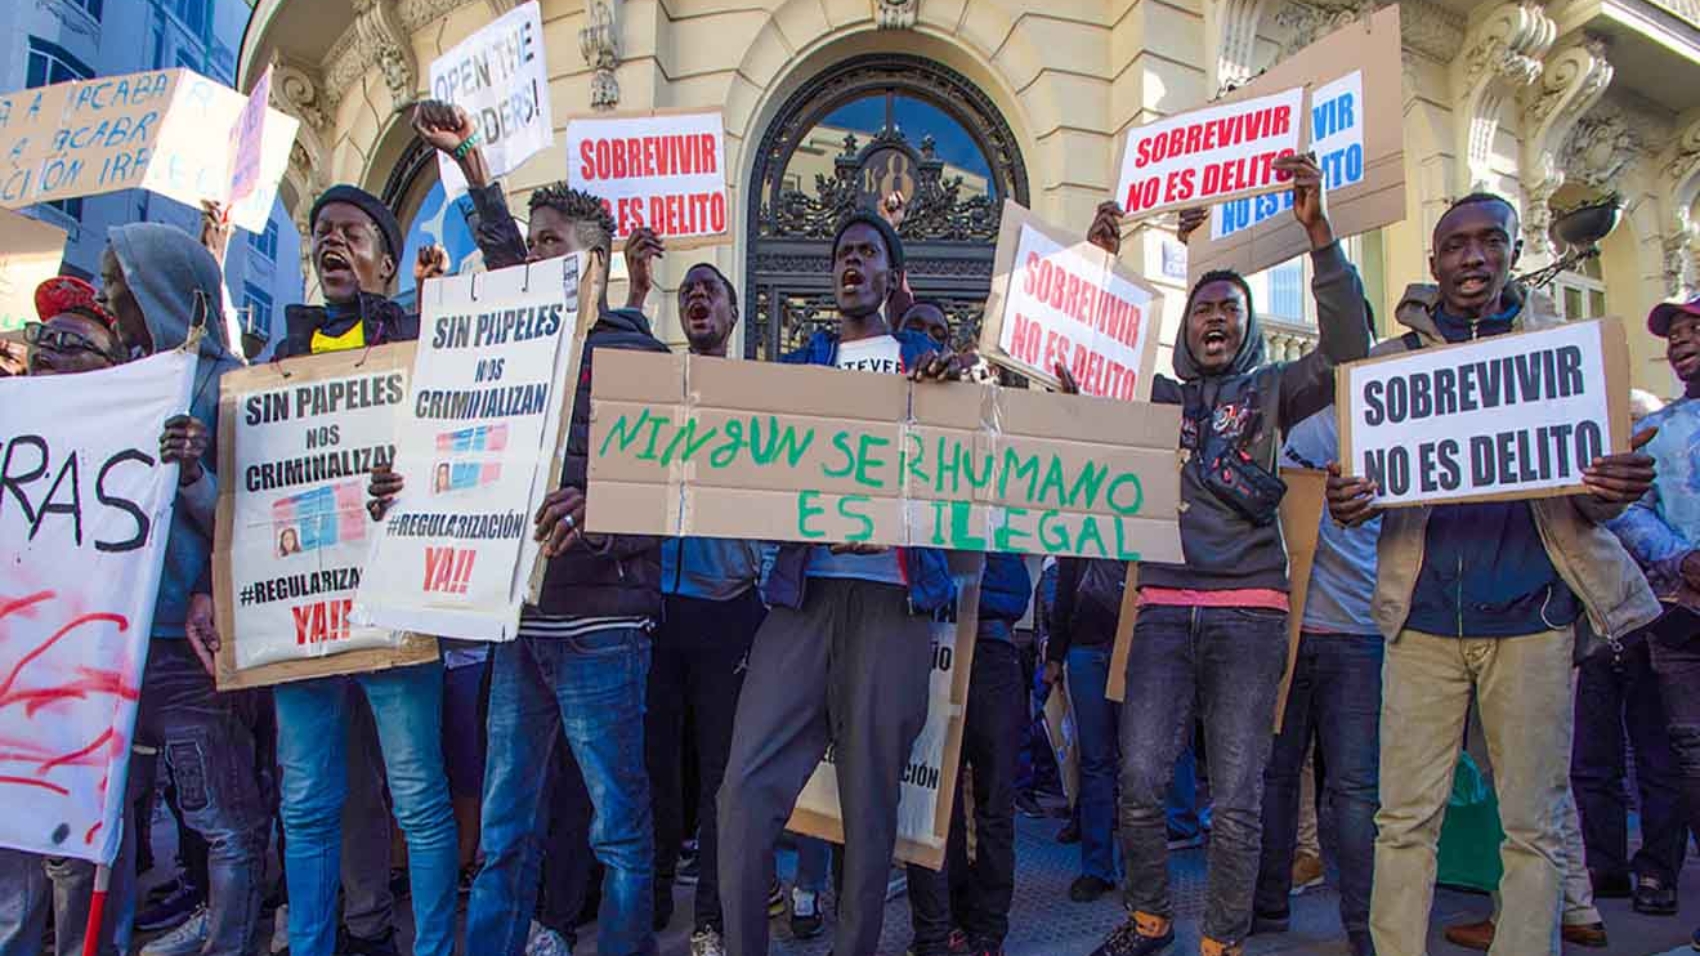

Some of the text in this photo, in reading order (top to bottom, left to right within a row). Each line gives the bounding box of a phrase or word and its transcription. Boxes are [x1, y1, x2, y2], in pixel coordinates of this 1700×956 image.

[435, 50, 491, 106] OPEN
[580, 133, 717, 182] SOBREVIVIR
[1135, 105, 1291, 169] SOBREVIVIR
[1126, 148, 1297, 212] NO ES DELITO
[618, 196, 645, 237] ES
[650, 192, 725, 237] DELITO
[1024, 250, 1141, 349] SOBREVIVIR
[432, 313, 472, 349] SIN
[1010, 312, 1137, 402] NO ES DELITO
[246, 374, 403, 426] SIN PAPELES
[1364, 345, 1584, 426] SOBREVIVIR
[307, 425, 340, 449] NOS
[1364, 420, 1602, 497] NO ES DELITO
[934, 436, 1144, 515] HUMANO
[387, 508, 525, 540] #REGULARIZACIÓN
[798, 489, 1142, 561] ES ILEGAL
[240, 567, 363, 607] #REGULARIZA
[422, 547, 476, 594] YA!!
